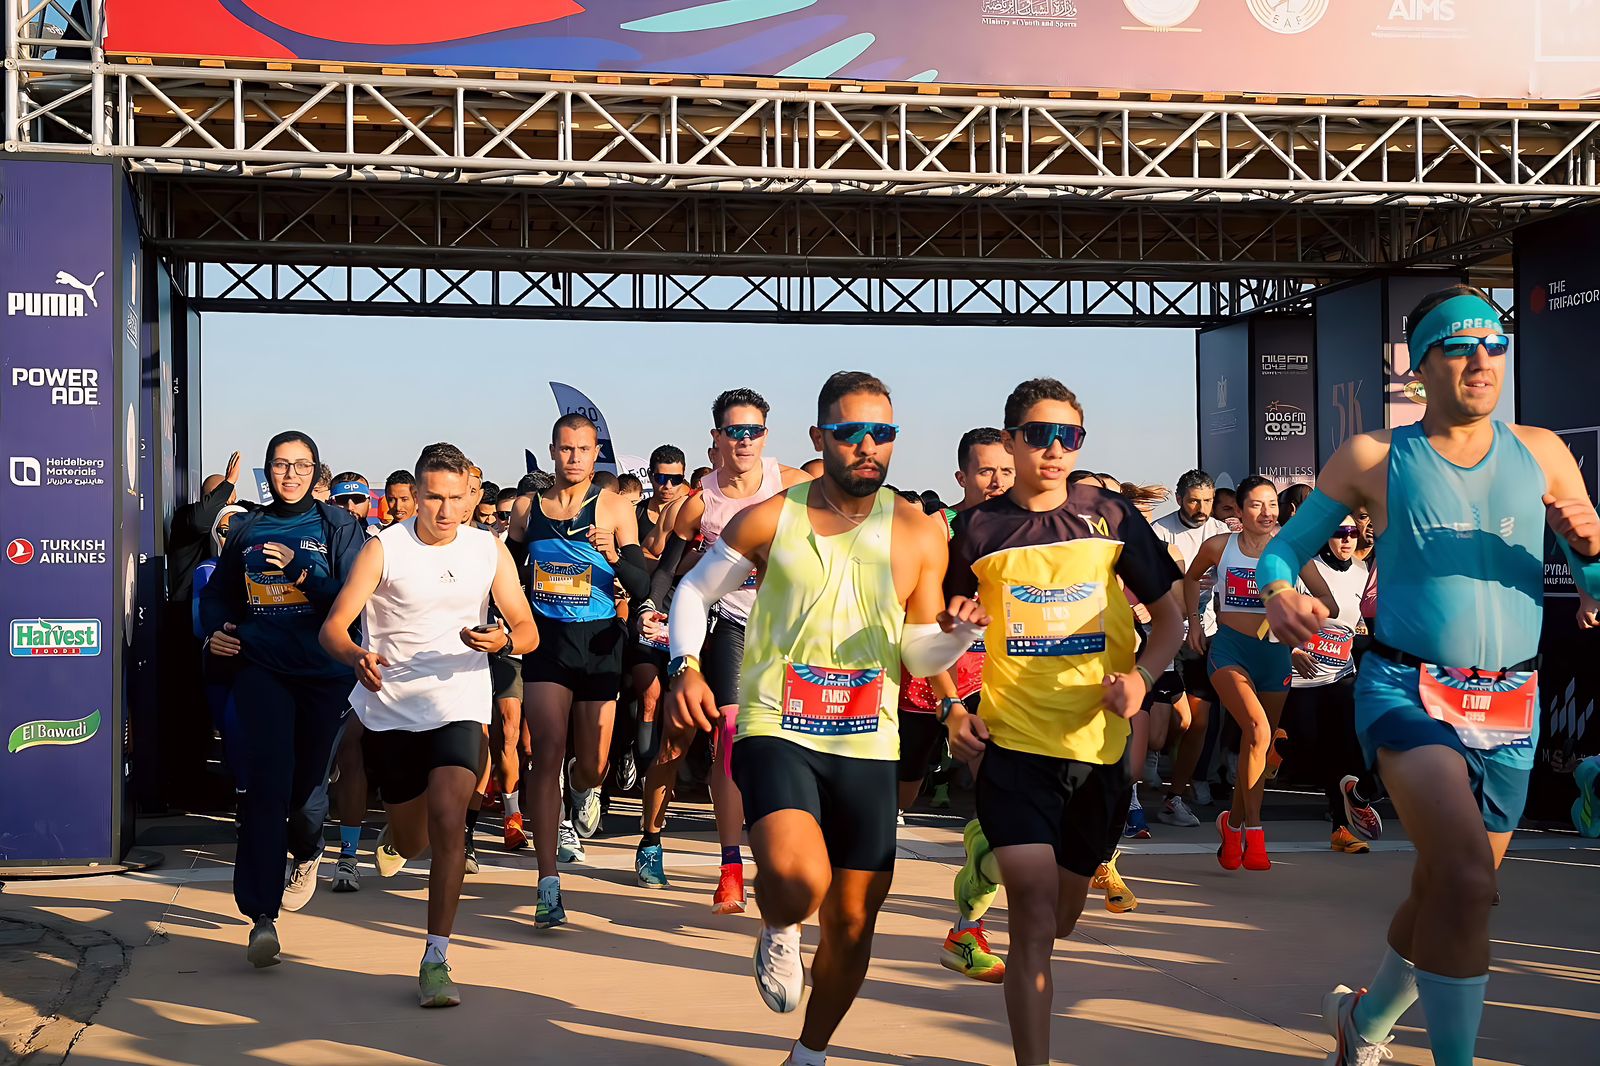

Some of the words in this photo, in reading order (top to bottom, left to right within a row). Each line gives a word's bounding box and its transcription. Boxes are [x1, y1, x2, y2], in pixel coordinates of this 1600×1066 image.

[1548, 280, 1566, 294] THE
[8, 292, 84, 317] PUMA
[12, 367, 98, 387] POWER
[51, 387, 98, 405] ADE
[1264, 412, 1291, 422] 100.6
[46, 457, 104, 468] Heidelberg
[46, 467, 97, 476] Materials
[1258, 466, 1314, 476] LIMITLESS
[40, 540, 105, 551] TURKISH
[39, 553, 106, 564] AIRLINES
[1544, 563, 1571, 576] PYRA
[17, 625, 95, 646] Harvest
[22, 725, 34, 741] El
[38, 721, 87, 738] Bawadi
